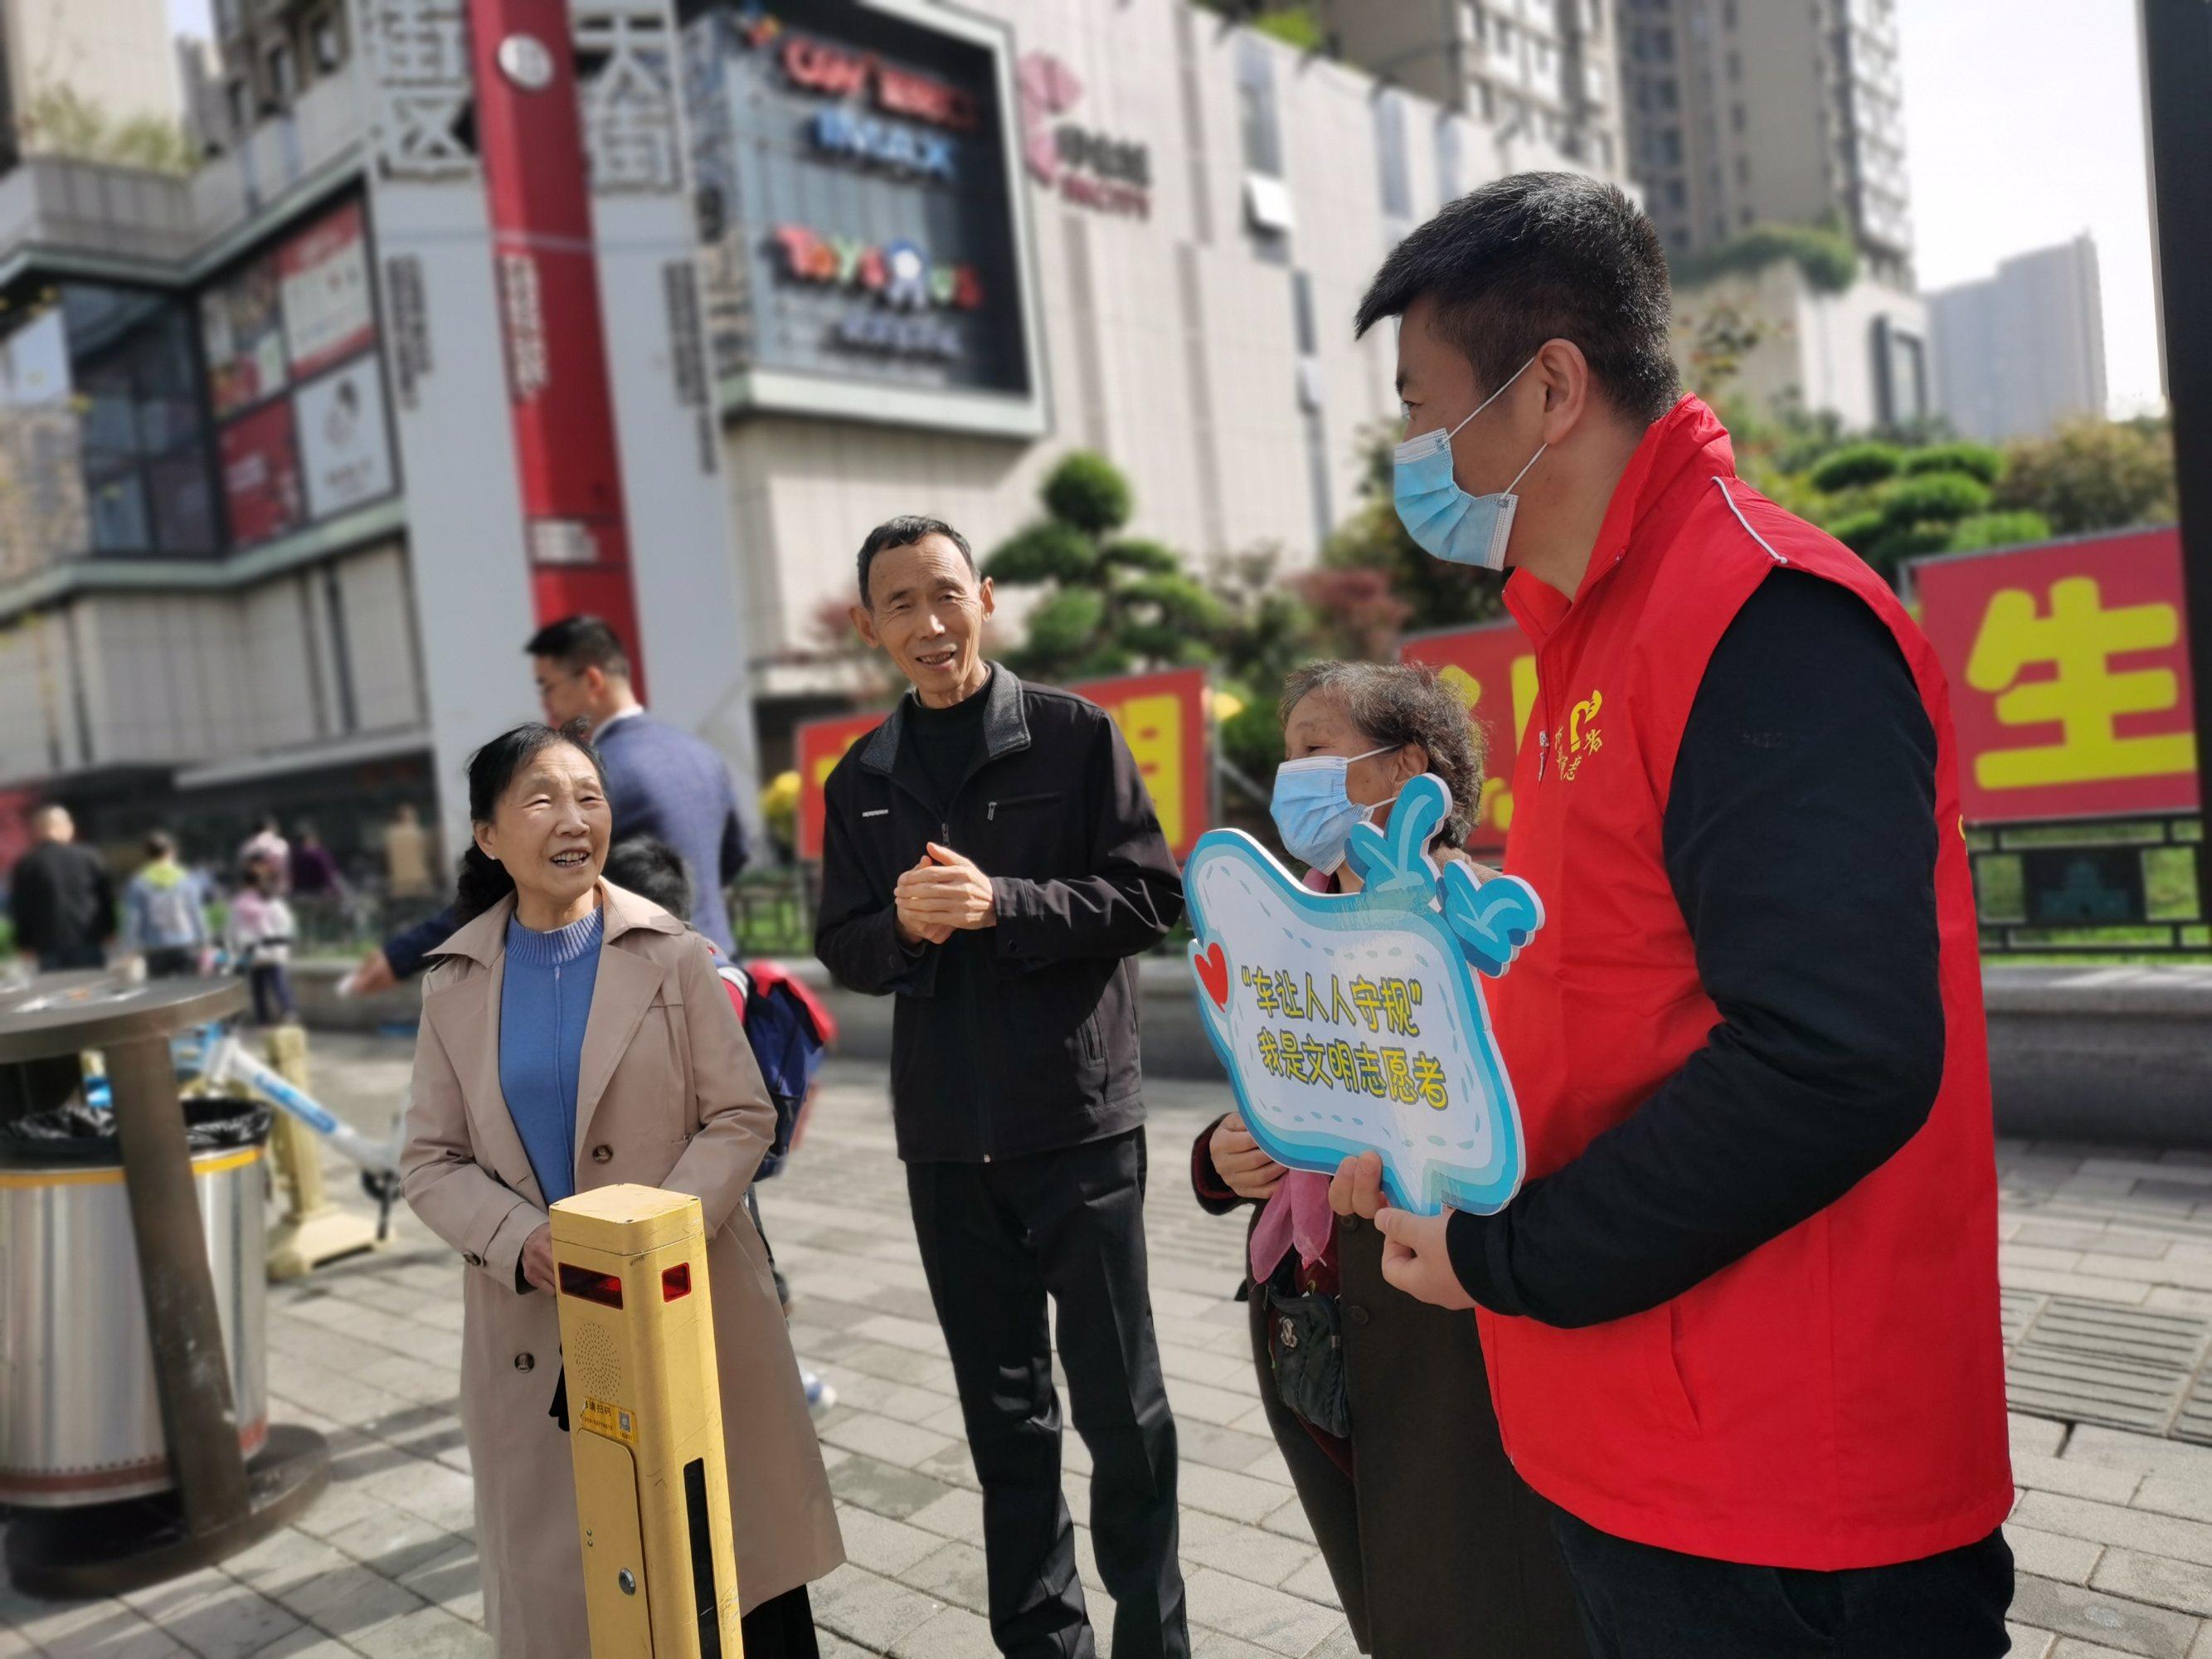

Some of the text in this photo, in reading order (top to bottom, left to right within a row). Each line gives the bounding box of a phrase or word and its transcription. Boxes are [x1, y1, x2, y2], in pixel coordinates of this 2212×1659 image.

[1966, 577, 2197, 791] 生
[1257, 1026, 1449, 1111] 我是文明志愿者
